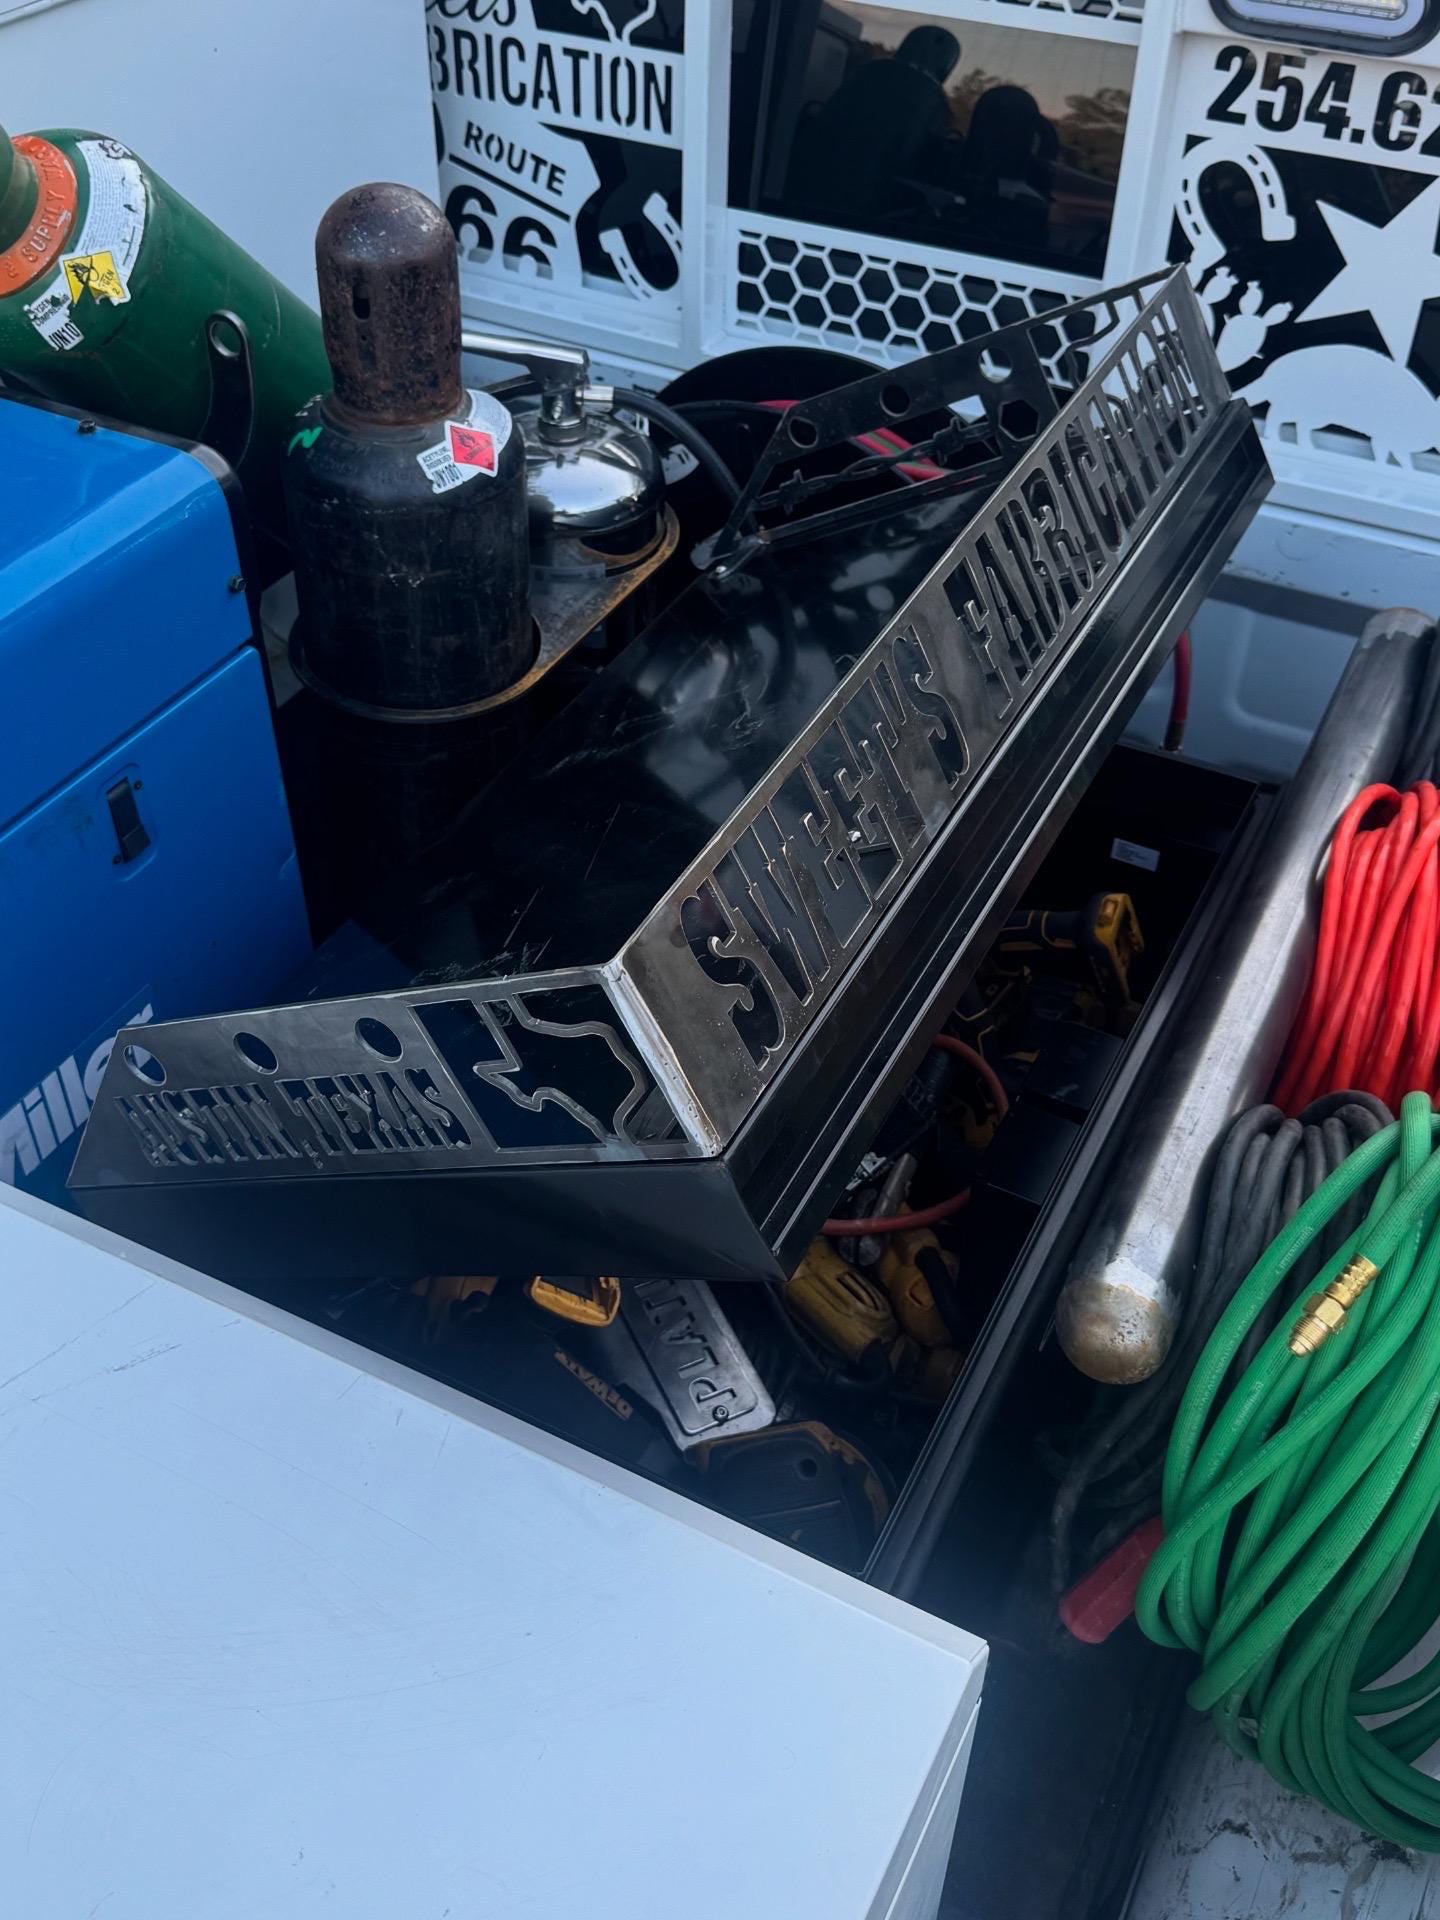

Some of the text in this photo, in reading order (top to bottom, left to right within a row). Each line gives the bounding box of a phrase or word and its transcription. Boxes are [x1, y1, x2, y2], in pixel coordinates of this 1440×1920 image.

[463, 120, 566, 196] ROUTE
[445, 184, 558, 280] 66
[680, 298, 1206, 1070] SWEET'S FABRICATION
[275, 1068, 472, 1158] TEXAS
